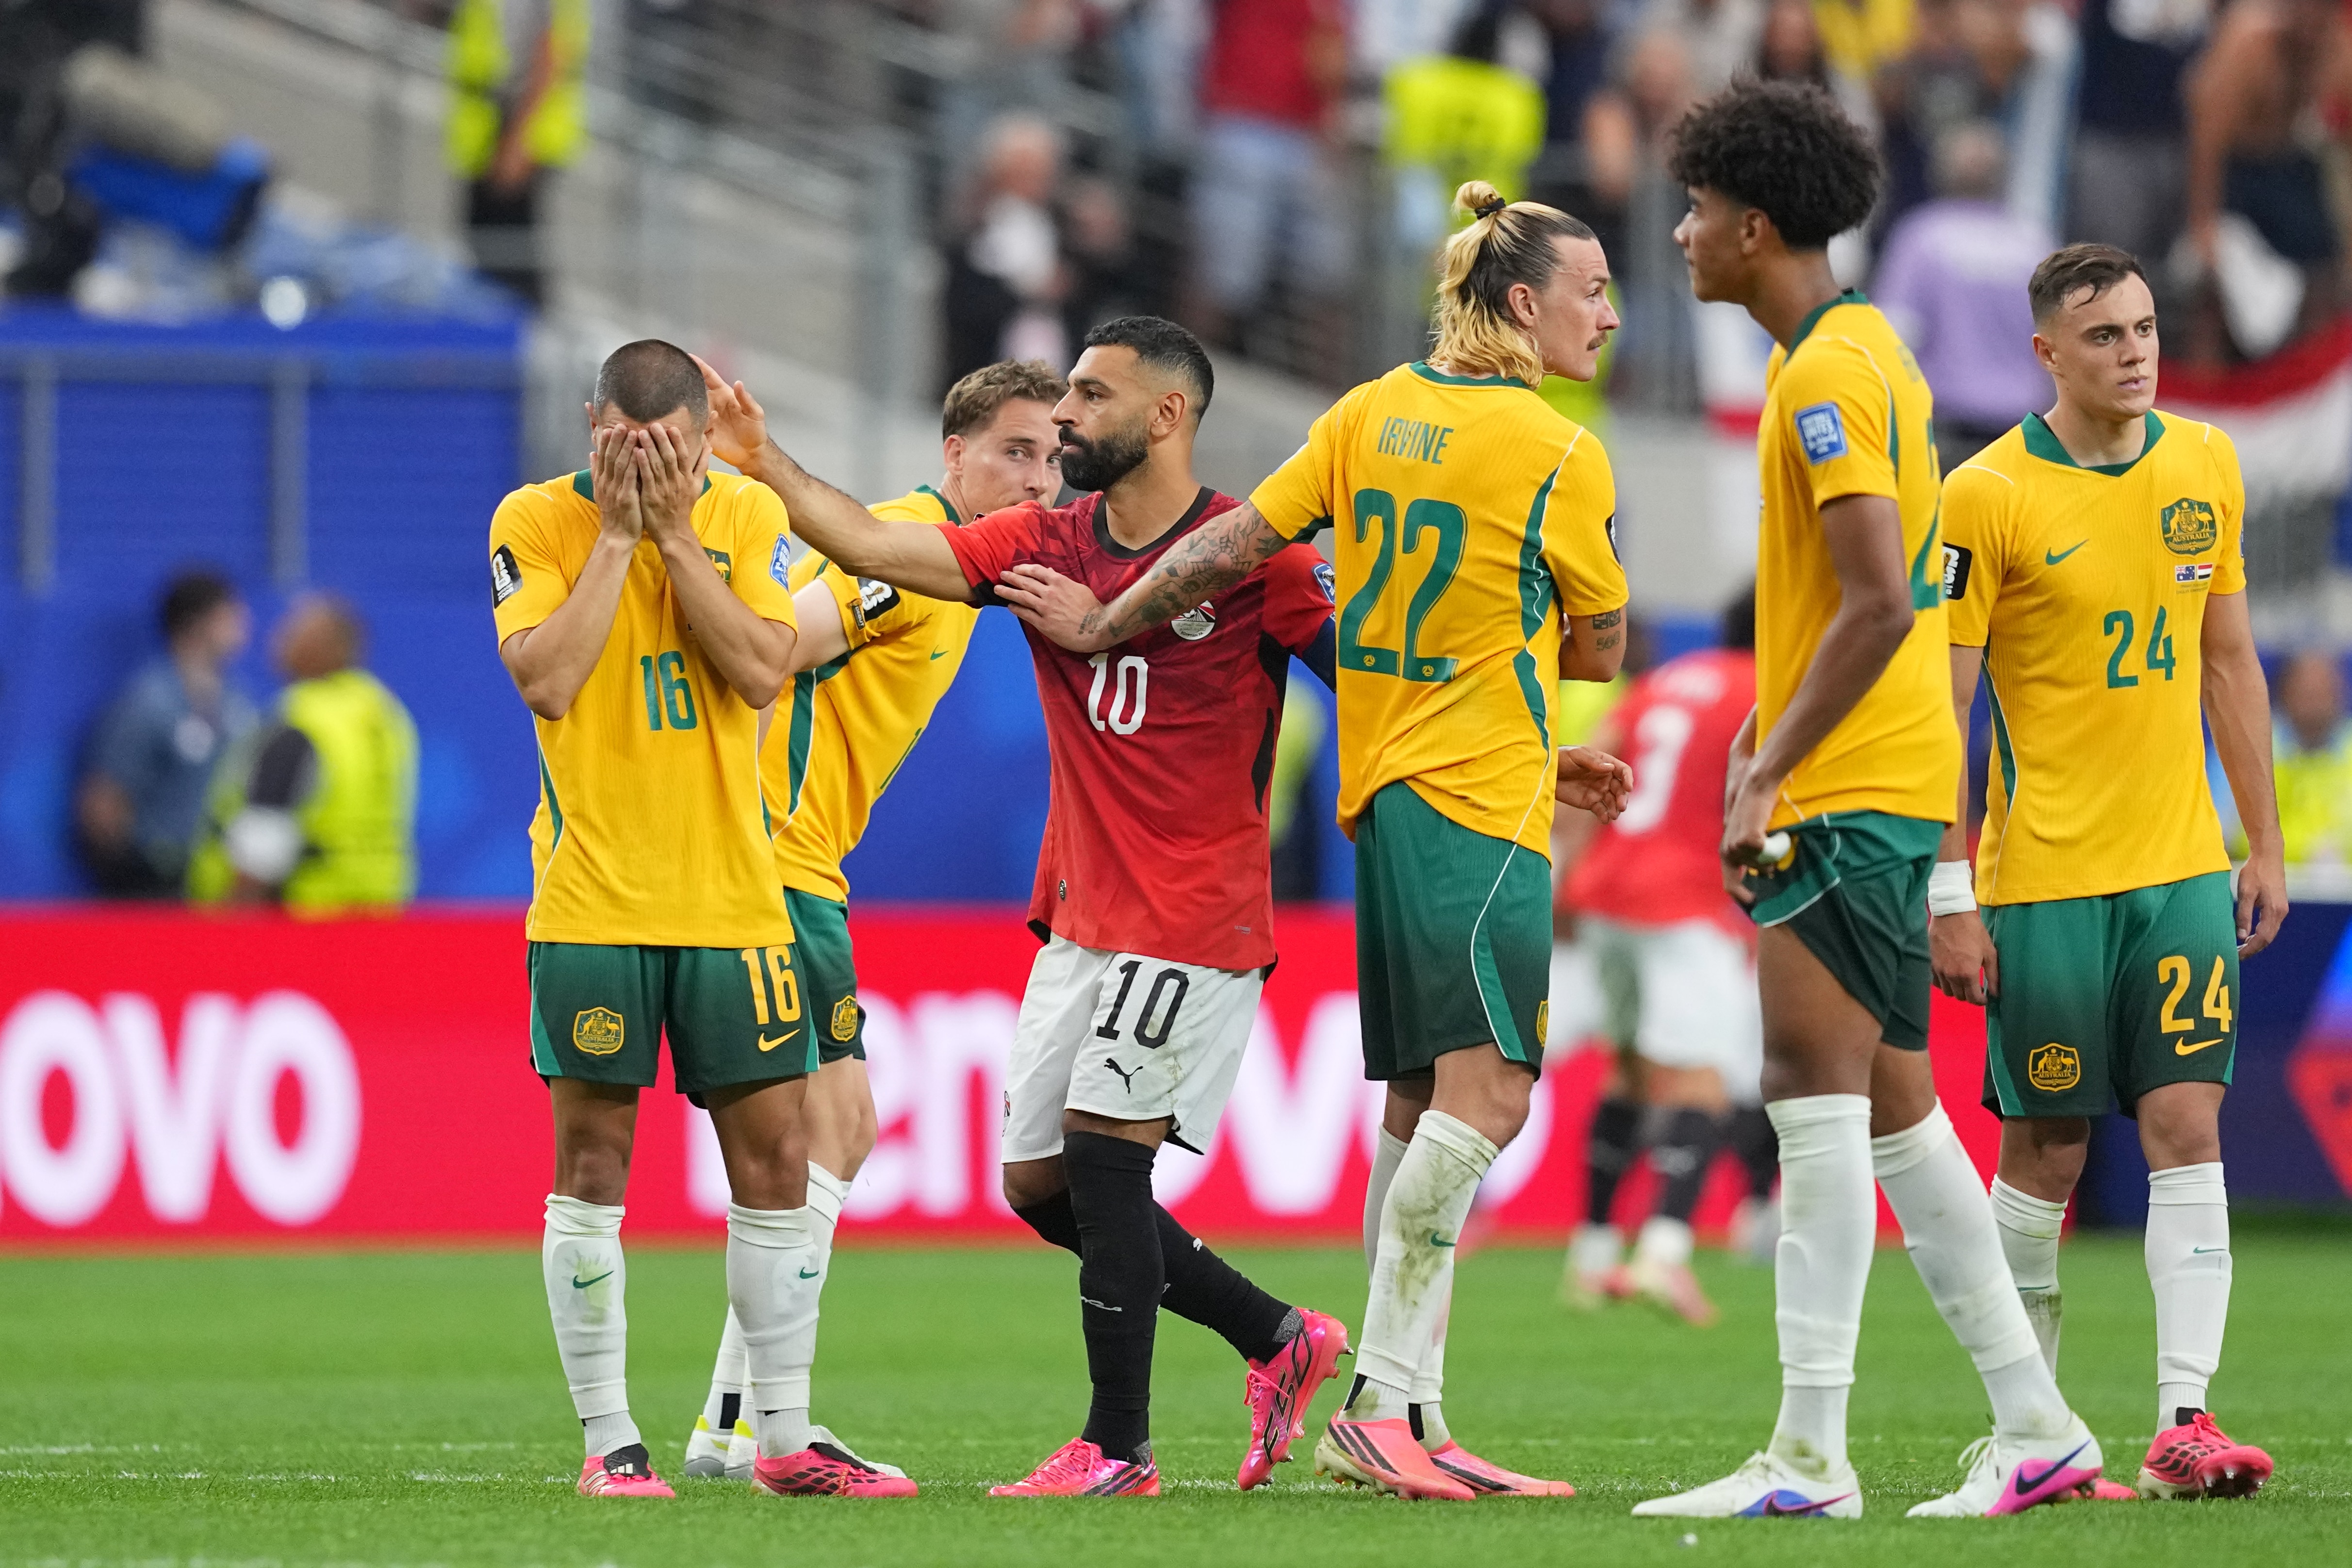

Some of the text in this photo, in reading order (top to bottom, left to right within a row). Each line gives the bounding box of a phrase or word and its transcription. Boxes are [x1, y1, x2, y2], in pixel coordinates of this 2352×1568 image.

[1378, 416, 1454, 464] IRVINE
[2172, 532, 2210, 543] AUSTRALIA
[855, 606, 864, 626] DEBUT
[1338, 488, 1468, 682] 22
[2104, 605, 2176, 689] 24
[640, 650, 697, 731] 16
[1087, 652, 1149, 735] 10
[741, 945, 801, 1024] 16
[1096, 960, 1190, 1049] 10
[2158, 955, 2232, 1034] 24
